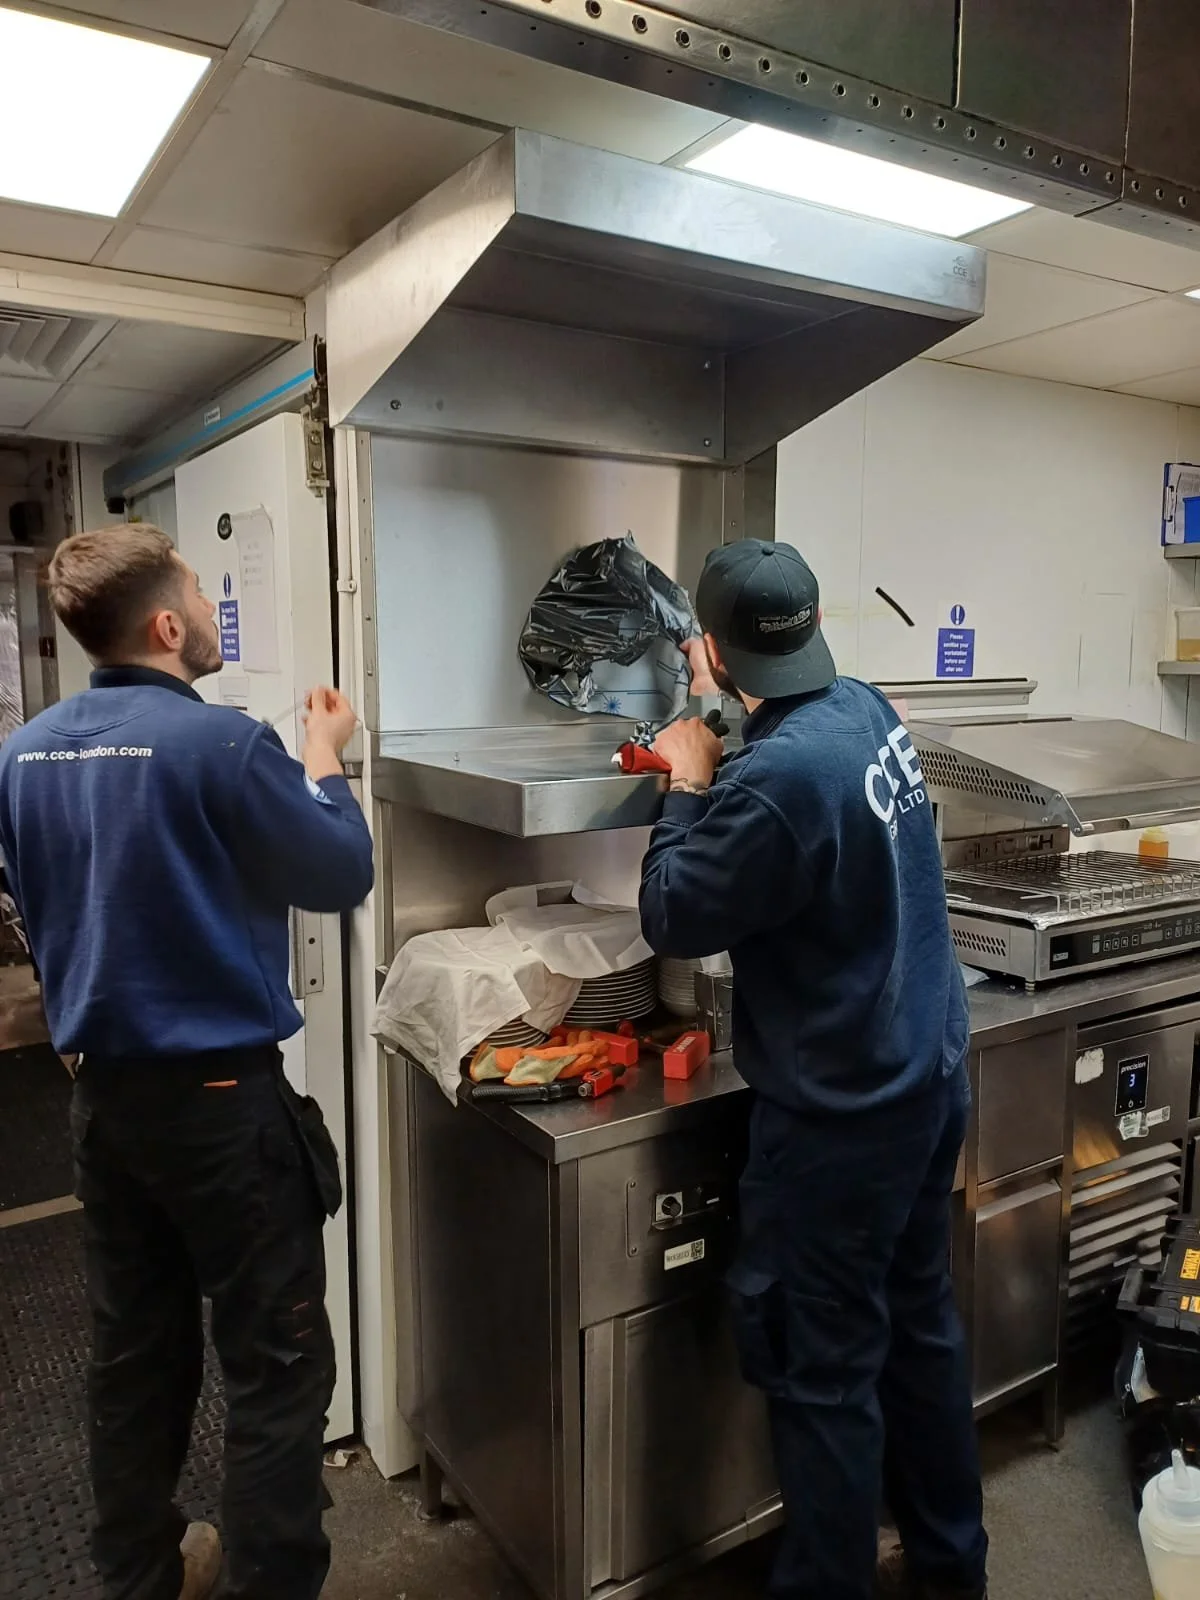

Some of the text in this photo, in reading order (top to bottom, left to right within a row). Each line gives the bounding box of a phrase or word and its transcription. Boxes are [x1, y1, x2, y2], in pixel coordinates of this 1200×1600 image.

[953, 265, 968, 276] CCE
[17, 744, 153, 763] www.cce-london.com
[898, 788, 925, 815] LTD
[1120, 1061, 1146, 1075] precision
[1128, 1073, 1136, 1087] 3
